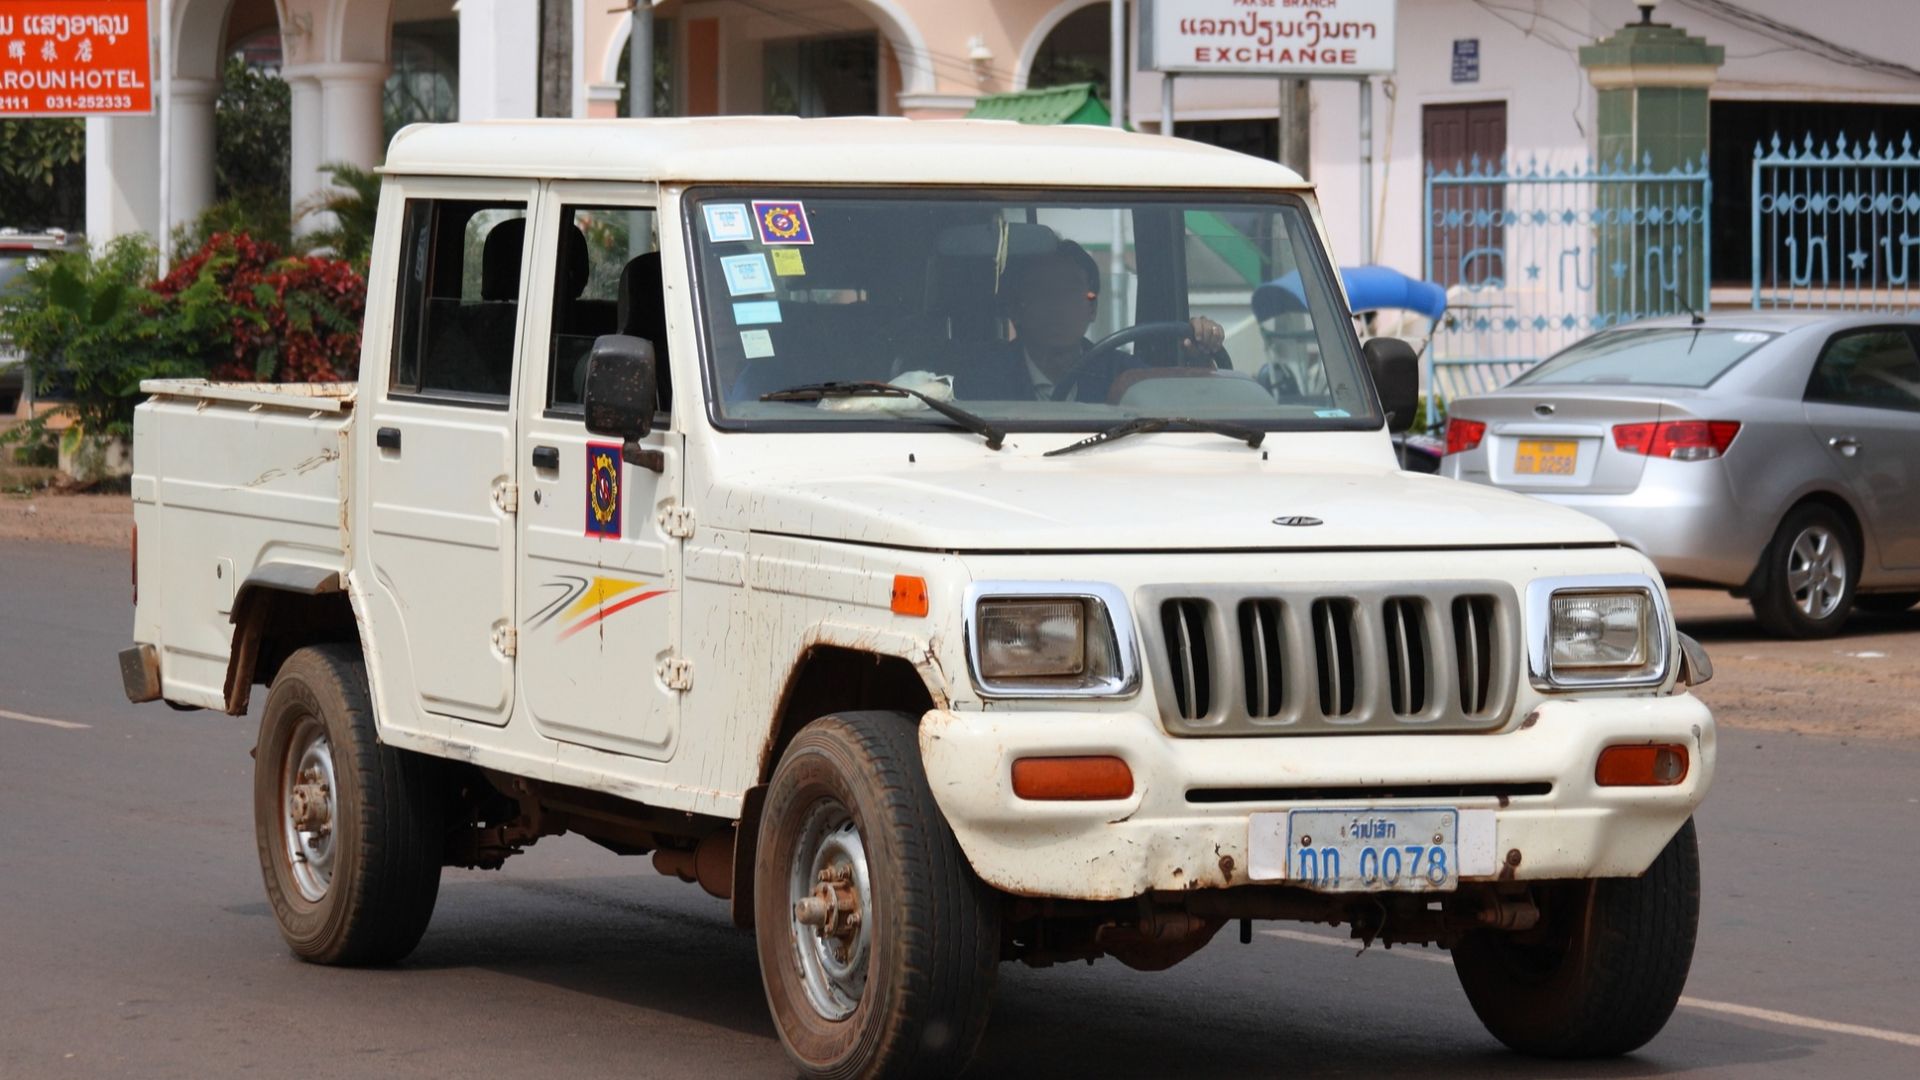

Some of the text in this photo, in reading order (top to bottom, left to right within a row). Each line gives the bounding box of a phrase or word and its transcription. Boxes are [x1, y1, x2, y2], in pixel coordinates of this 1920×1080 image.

[1194, 47, 1358, 65] EXCHANGE
[70, 69, 145, 88] HOTEL
[46, 95, 131, 109] 031-252333
[1359, 846, 1449, 887] 0078
